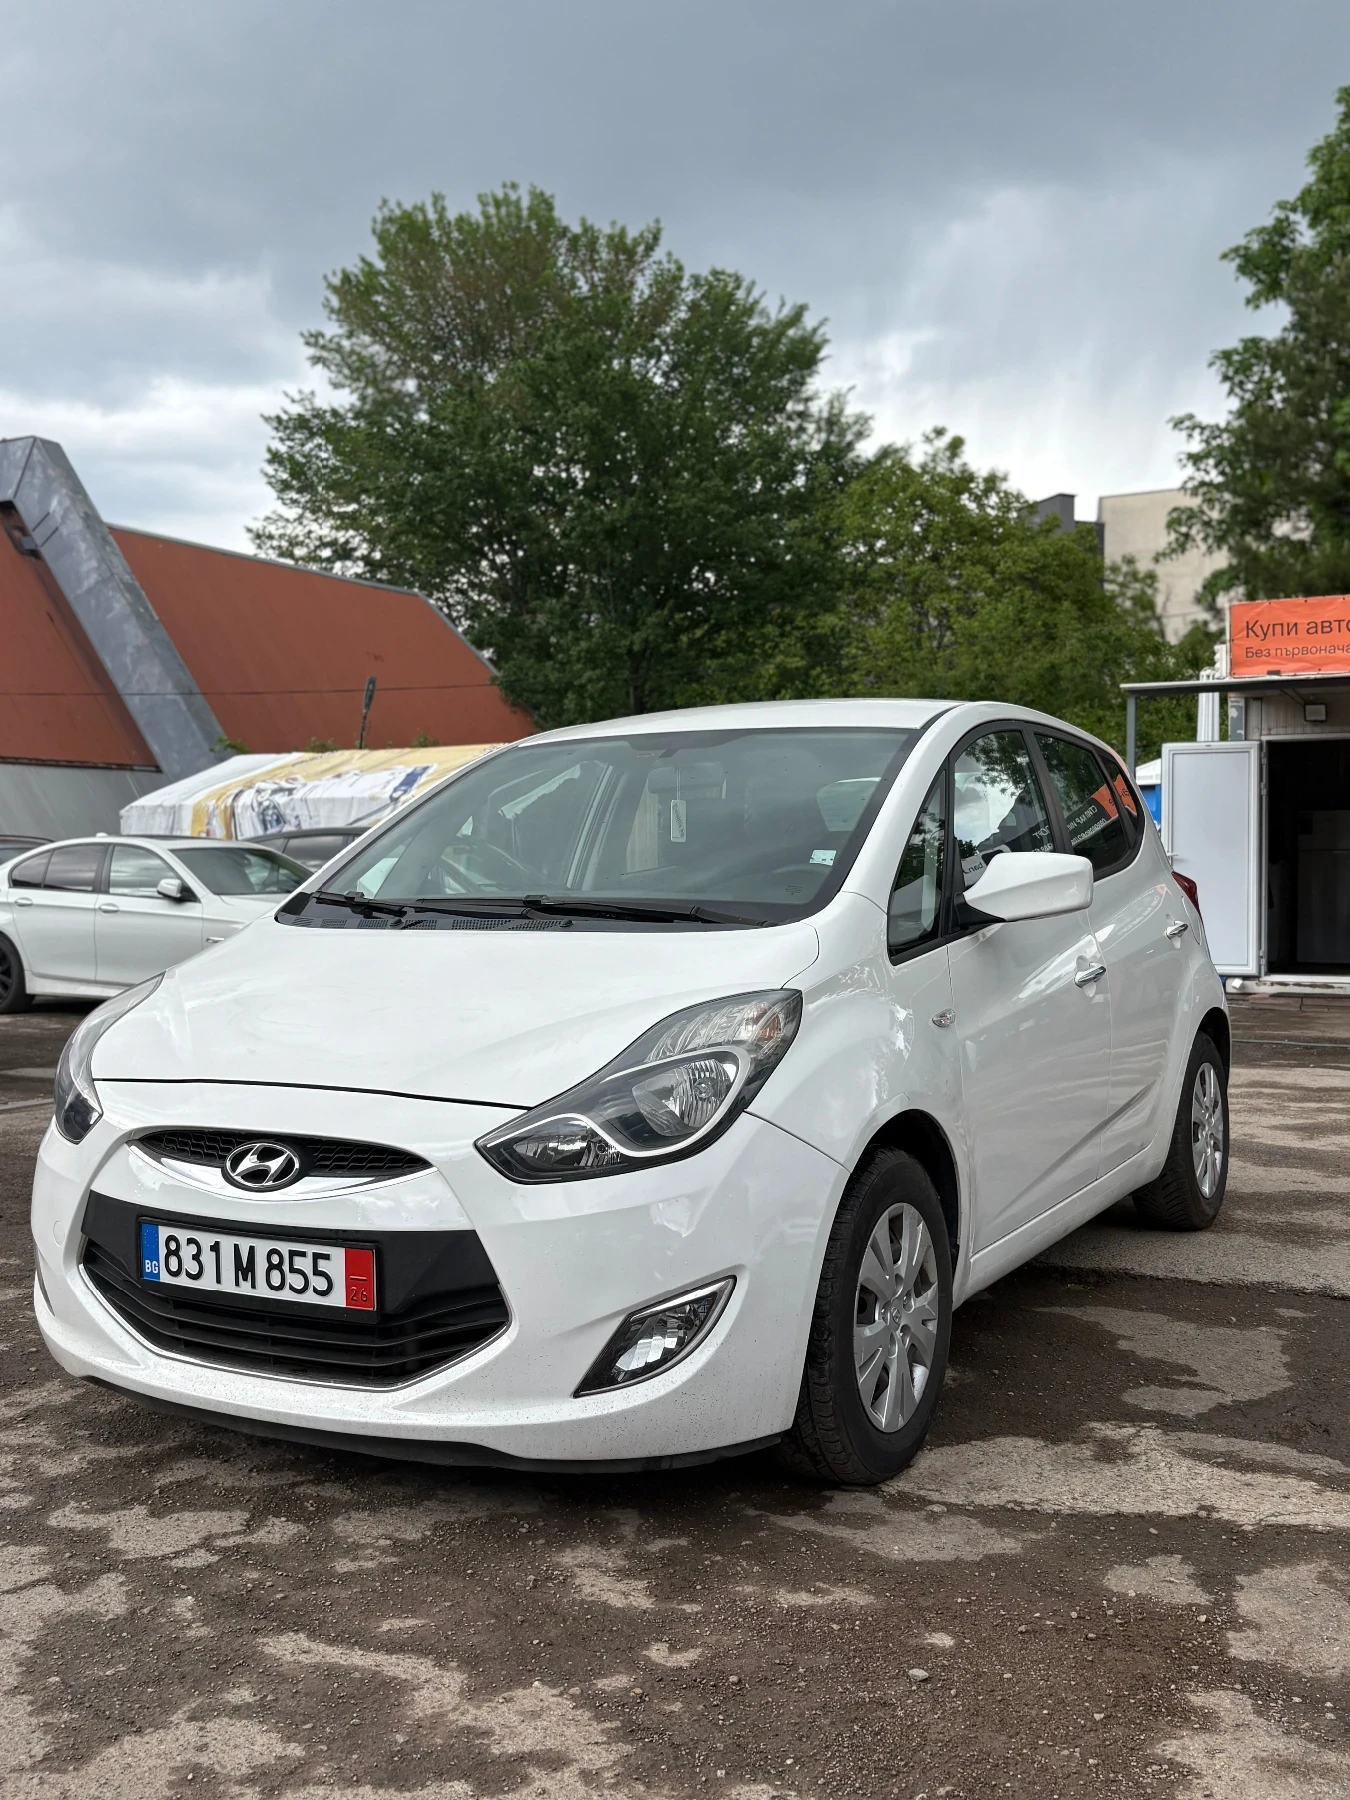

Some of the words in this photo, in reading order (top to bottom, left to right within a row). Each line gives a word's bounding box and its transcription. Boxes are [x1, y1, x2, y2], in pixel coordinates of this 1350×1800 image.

[1245, 620, 1298, 641] Купи
[1245, 647, 1271, 658] Без
[145, 1259, 159, 1273] BG
[164, 1234, 222, 1285] 831
[233, 1243, 257, 1289] M
[266, 1248, 334, 1297] 855
[350, 1286, 368, 1302] 26
